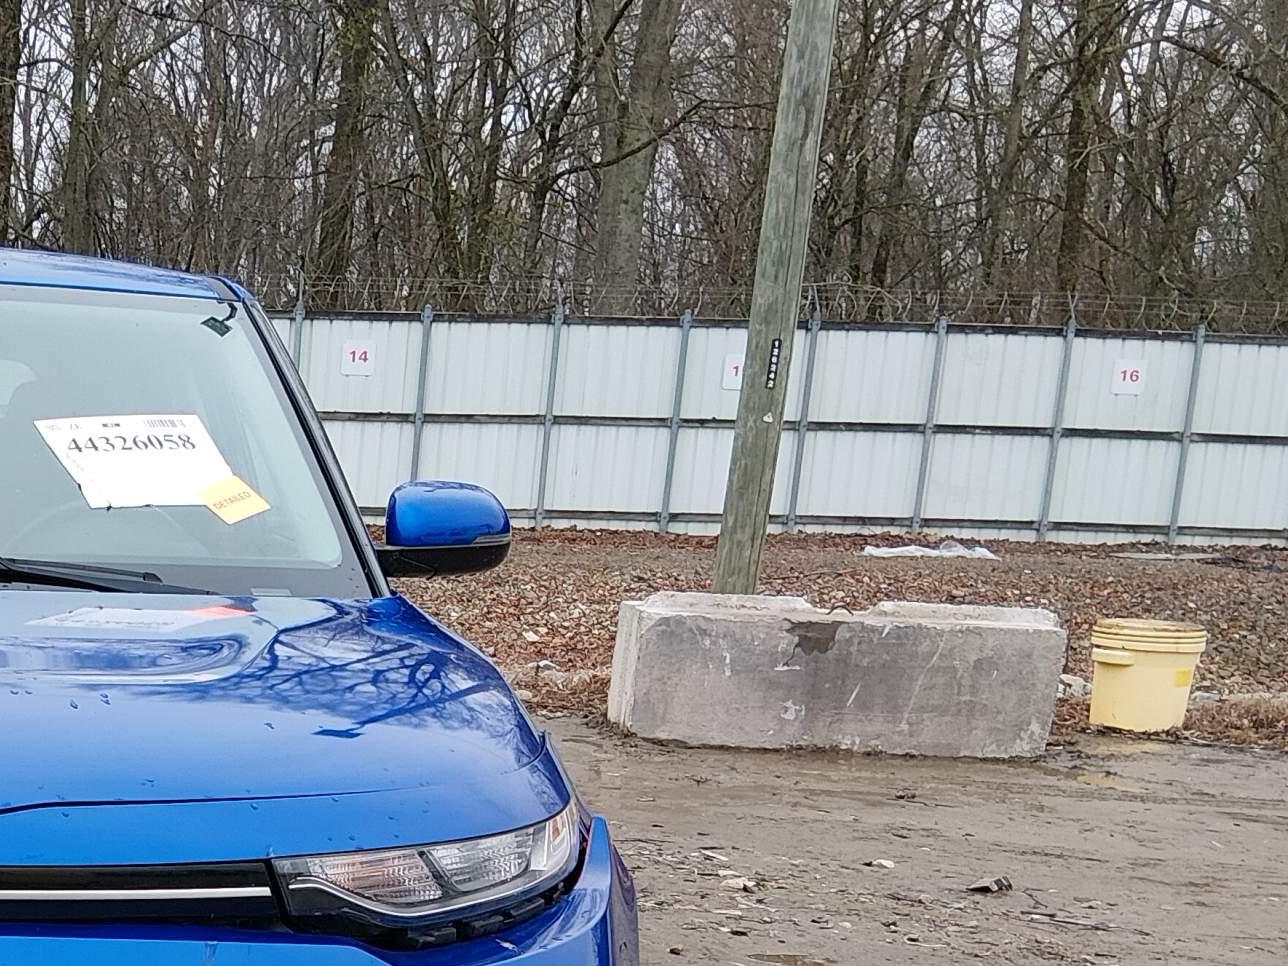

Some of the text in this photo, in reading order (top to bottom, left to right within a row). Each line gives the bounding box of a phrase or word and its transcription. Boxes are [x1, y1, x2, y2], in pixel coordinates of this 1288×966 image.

[349, 350, 369, 363] 14
[1121, 369, 1140, 382] 16
[67, 433, 197, 453] 44326058
[213, 490, 252, 512] DETAILED
